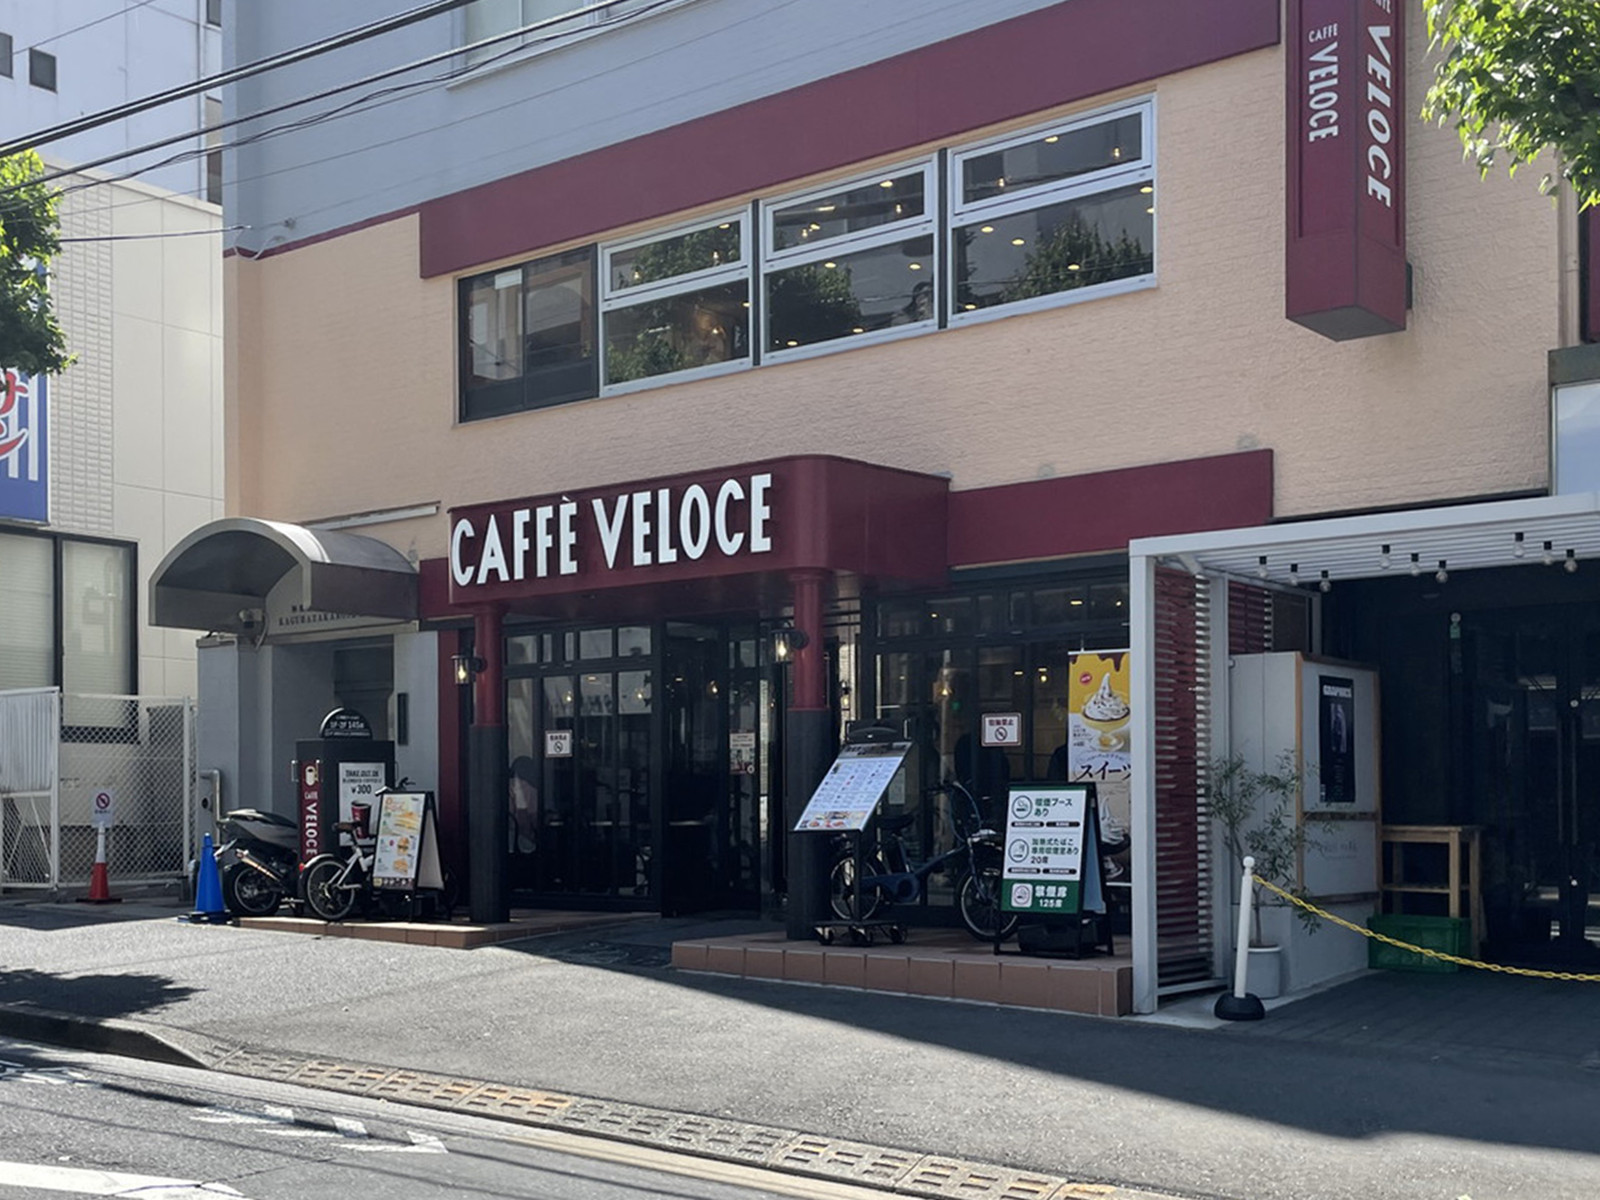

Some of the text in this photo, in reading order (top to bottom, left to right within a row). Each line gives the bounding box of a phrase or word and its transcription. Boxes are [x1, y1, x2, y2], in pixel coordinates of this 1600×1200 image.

[1309, 41, 1339, 143] VELOCE
[1368, 25, 1391, 208] VELOCE
[451, 473, 772, 586] CAFFÈ VELOCE
[305, 802, 318, 856] VELOCE
[1034, 808, 1050, 817] あり
